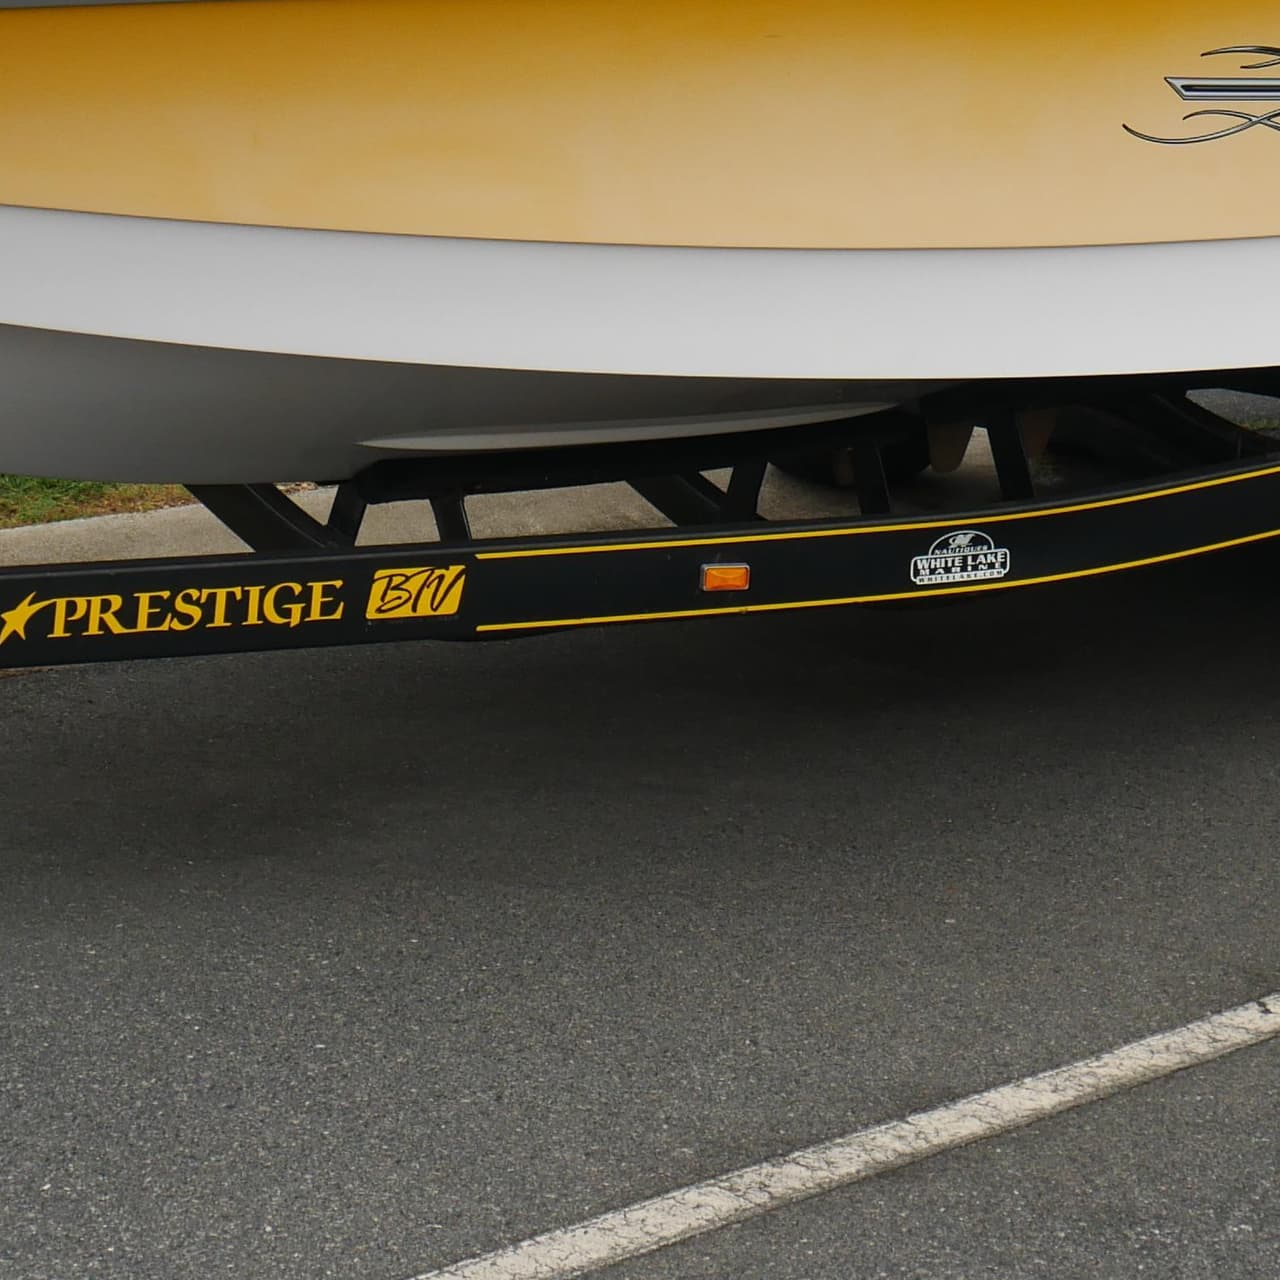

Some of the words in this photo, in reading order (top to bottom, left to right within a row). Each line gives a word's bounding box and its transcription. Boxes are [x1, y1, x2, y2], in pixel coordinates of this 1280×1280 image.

[917, 557, 963, 569] WHITE
[967, 552, 1005, 564] LAKE
[920, 563, 1001, 575] MARINE
[47, 579, 345, 640] PRESTIGE
